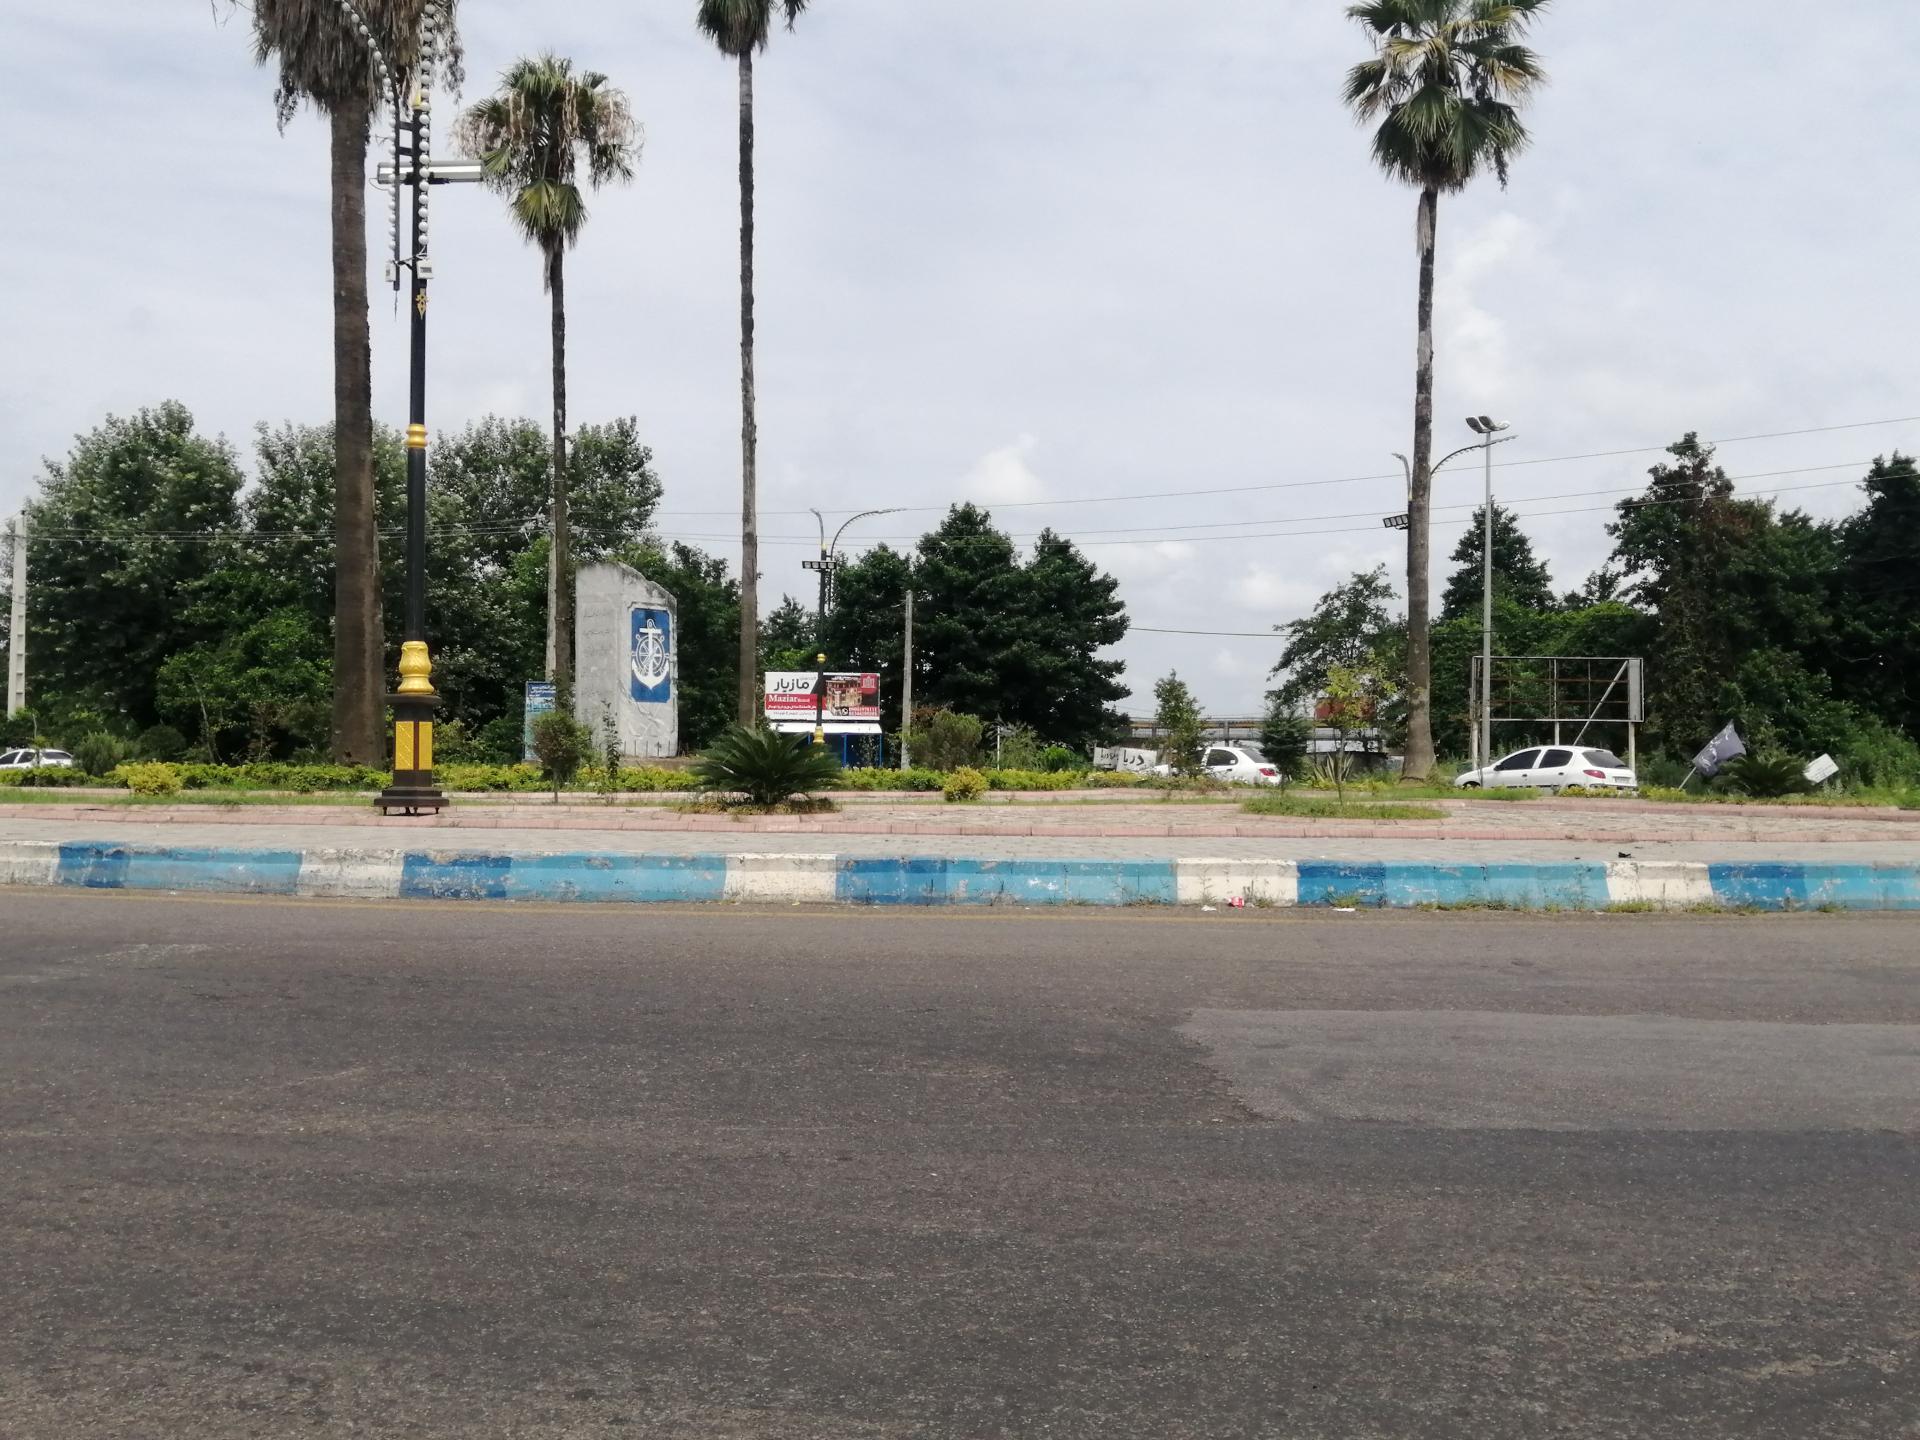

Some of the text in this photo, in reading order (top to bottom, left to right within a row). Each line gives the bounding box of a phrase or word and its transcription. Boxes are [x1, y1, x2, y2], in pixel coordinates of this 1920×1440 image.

[774, 678, 810, 693] مازیار
[768, 694, 798, 702] Maziar
[1123, 749, 1145, 766] دریا
